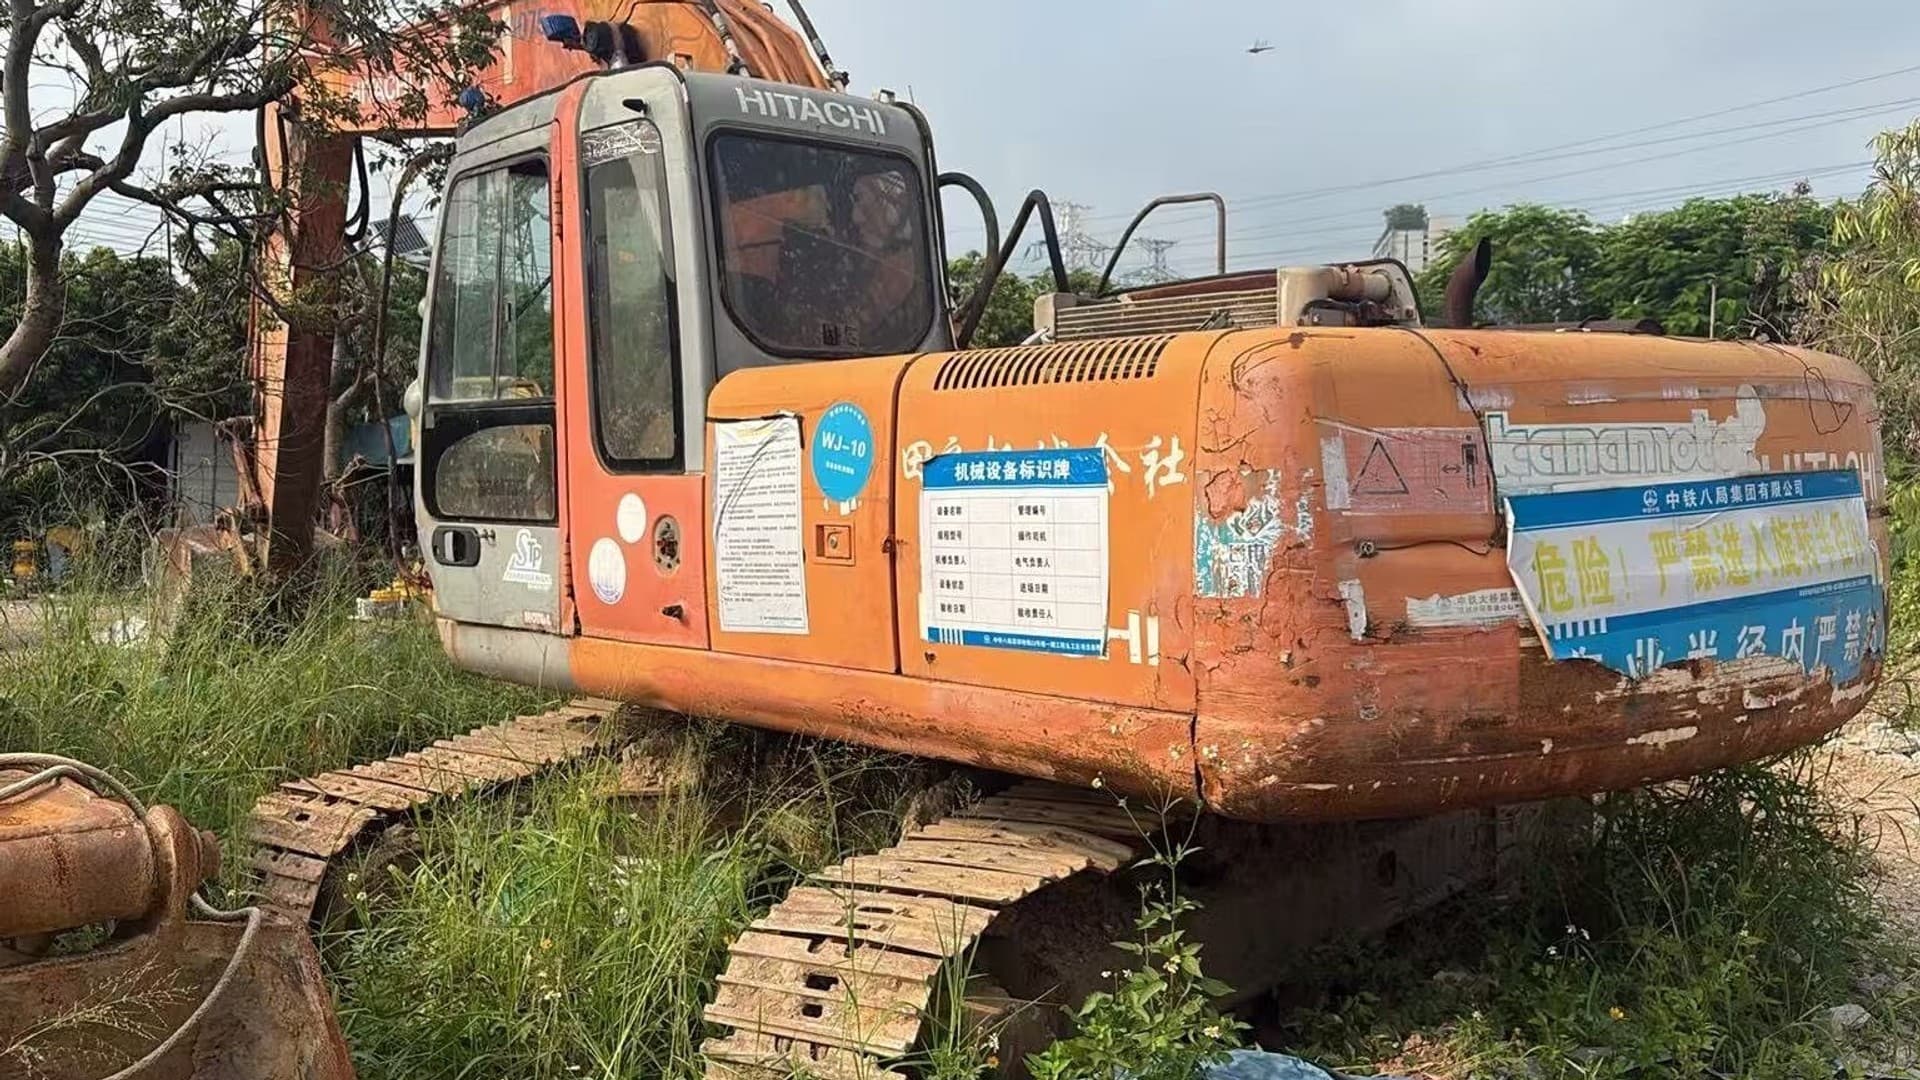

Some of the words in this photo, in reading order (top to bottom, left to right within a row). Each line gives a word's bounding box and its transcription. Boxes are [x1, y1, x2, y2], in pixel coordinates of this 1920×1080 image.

[735, 87, 885, 137] HITACHI
[822, 431, 867, 459] WJ-10
[955, 459, 1071, 482] 机械设备标识牌
[1666, 479, 1804, 510] 中铁八局集团有限公司
[1018, 505, 1046, 516] 管理编号
[1015, 557, 1051, 568] 电气负责人
[1572, 608, 1881, 680] 业半径内严禁
